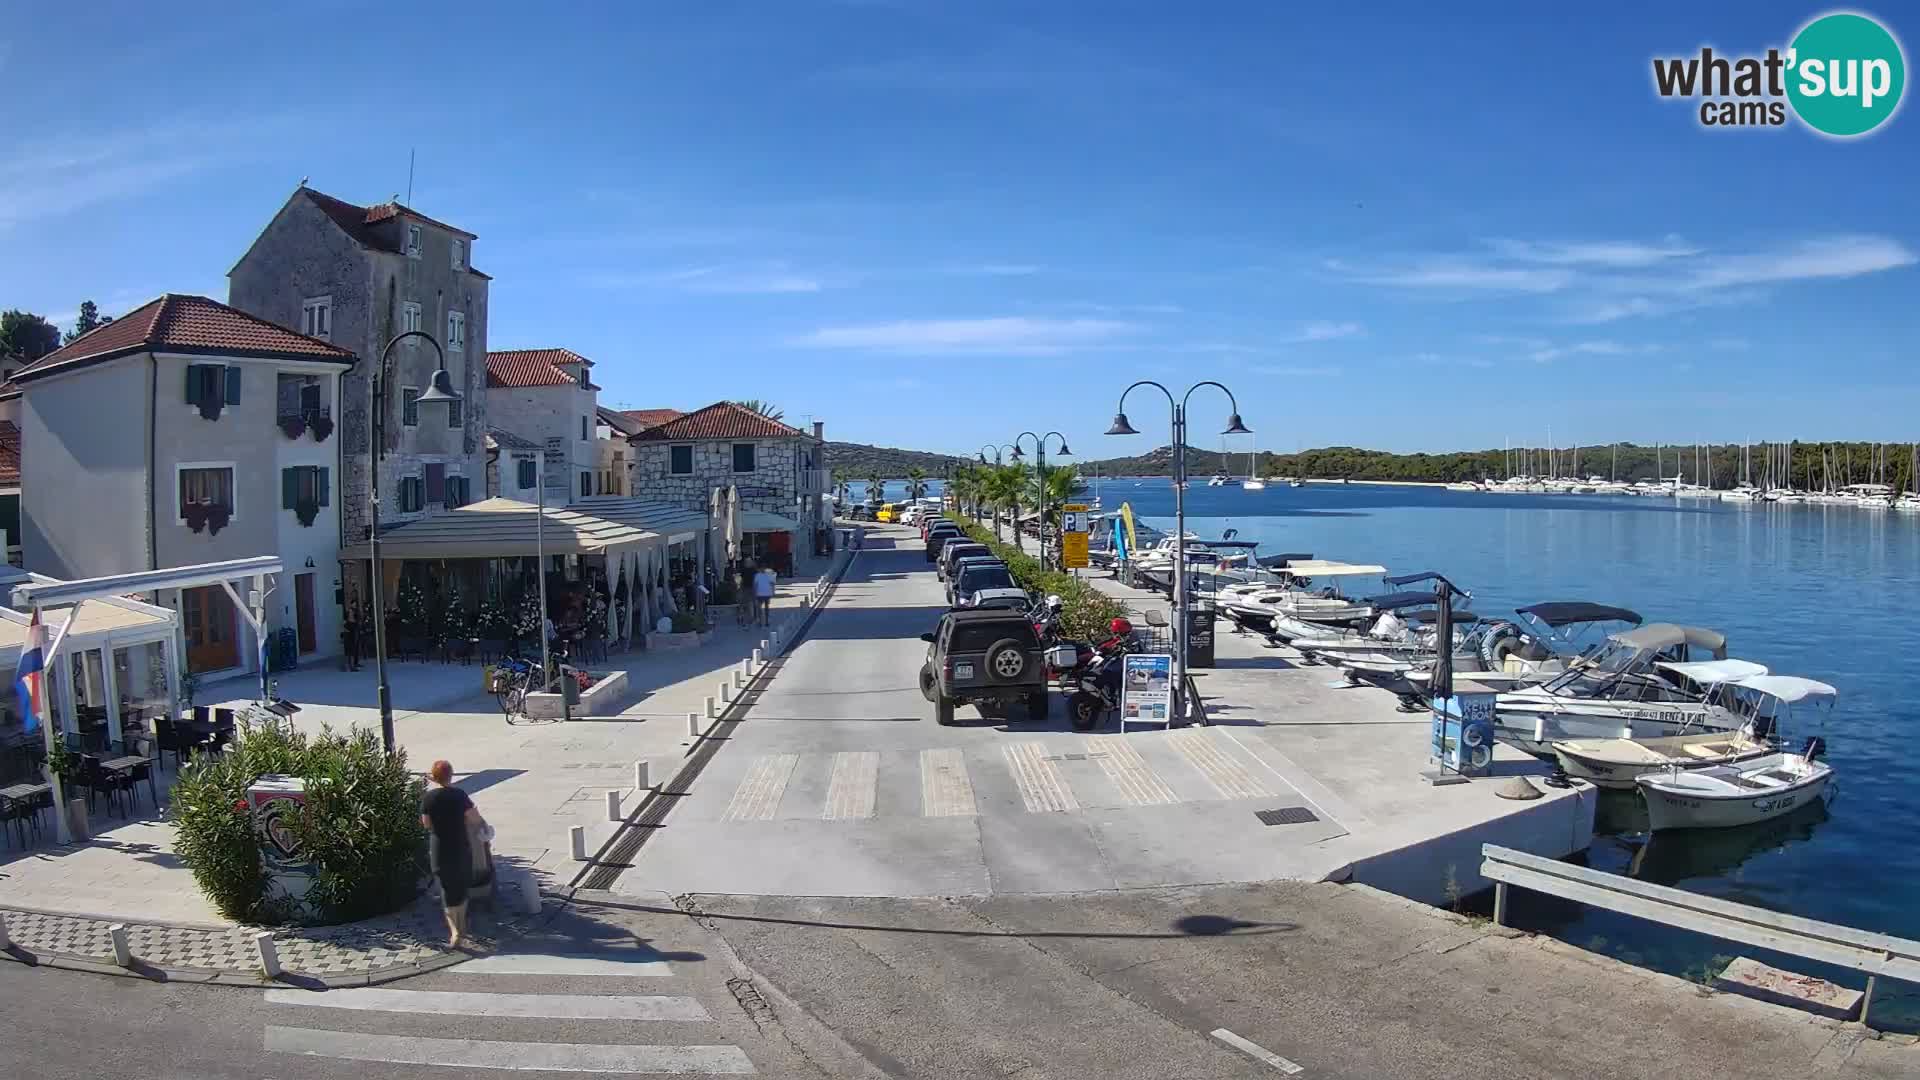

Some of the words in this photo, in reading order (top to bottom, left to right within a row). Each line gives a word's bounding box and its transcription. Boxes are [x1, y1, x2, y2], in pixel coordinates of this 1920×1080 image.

[1065, 514, 1075, 530] P
[1463, 700, 1494, 713] RENT
[1472, 711, 1494, 721] BOAT
[1660, 711, 1679, 721] RENT
